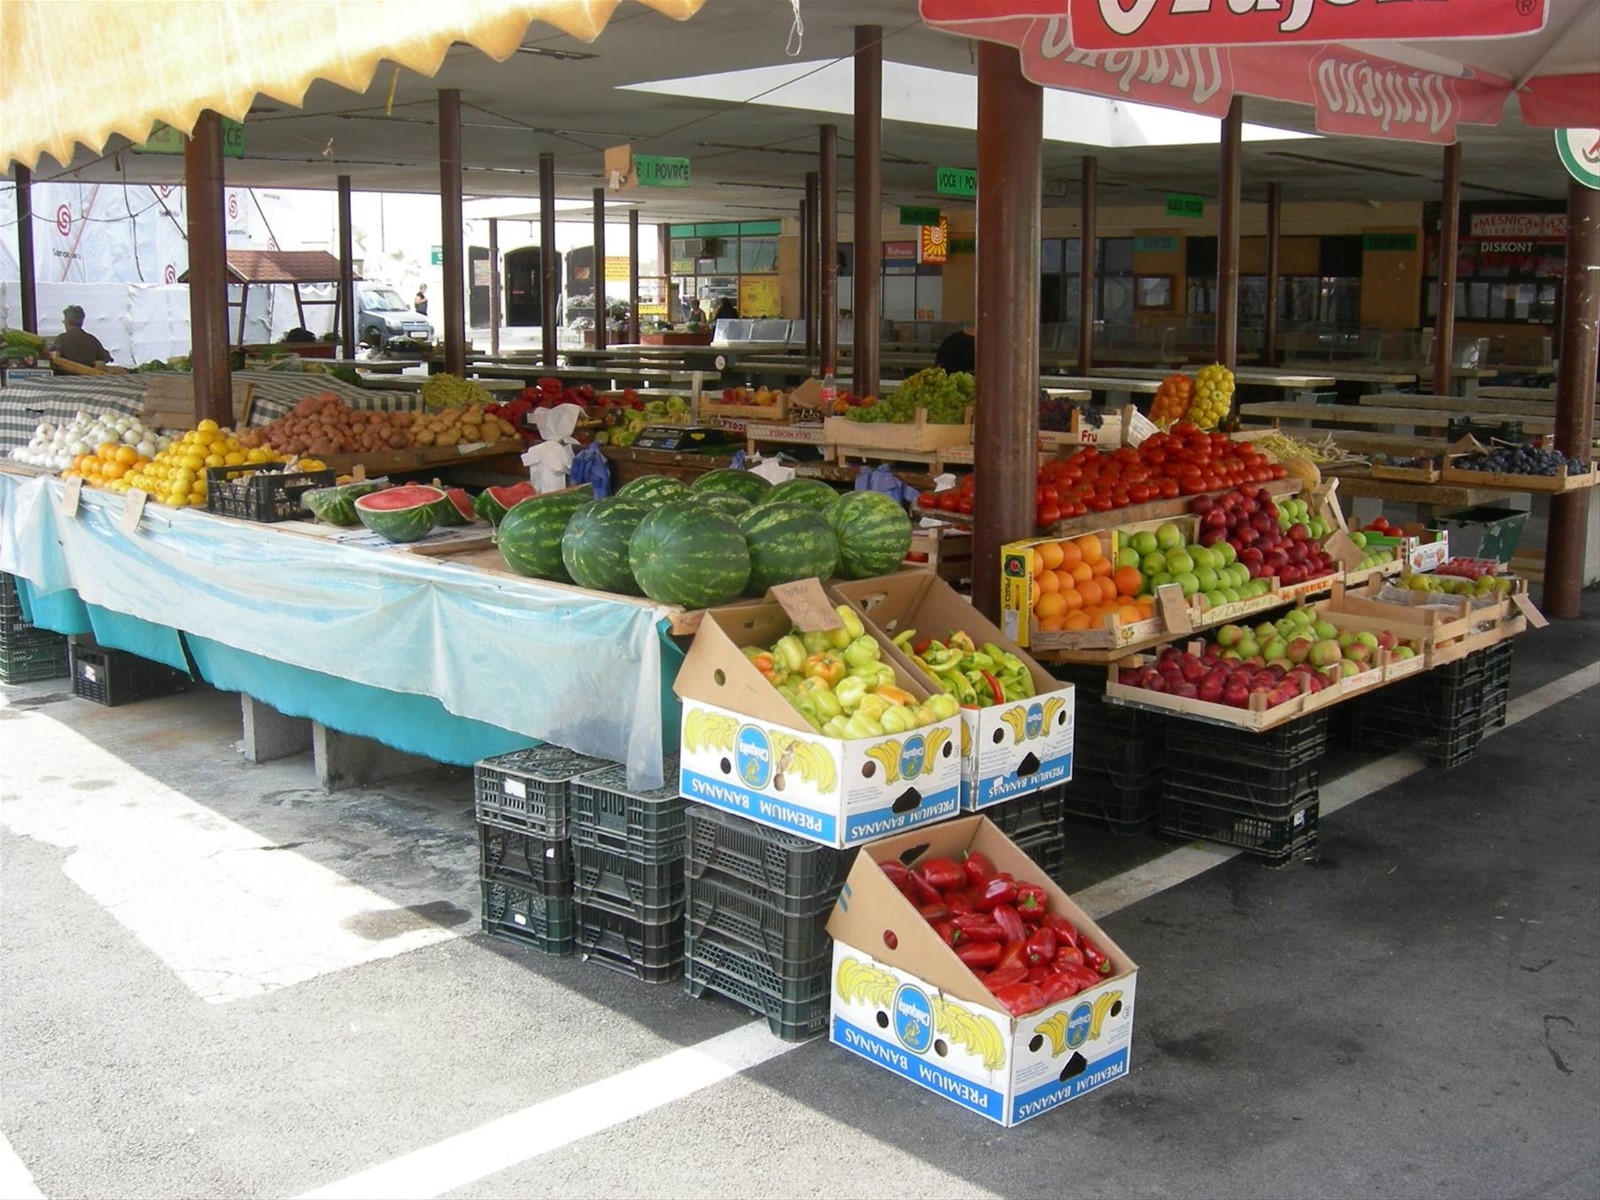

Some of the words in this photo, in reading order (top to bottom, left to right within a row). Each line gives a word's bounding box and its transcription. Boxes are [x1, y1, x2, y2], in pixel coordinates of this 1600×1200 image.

[655, 160, 689, 180] POVRĆE
[1479, 214, 1533, 228] MESNICA
[1481, 241, 1534, 252] DISKONT
[1081, 430, 1097, 442] Fru
[739, 738, 769, 763] Chiquita
[1031, 765, 1065, 784] PREMIUM
[692, 779, 750, 809] BANANAS
[760, 800, 823, 833] PREMIUM
[851, 811, 905, 839] BANANAS
[909, 798, 955, 826] PREMIUM
[898, 996, 930, 1027] Chiquita
[845, 1028, 908, 1070] BANANAS
[919, 1064, 988, 1108] PREMIUM
[1076, 1060, 1123, 1092] PREMIUM
[1019, 1085, 1072, 1119] BANANAS
